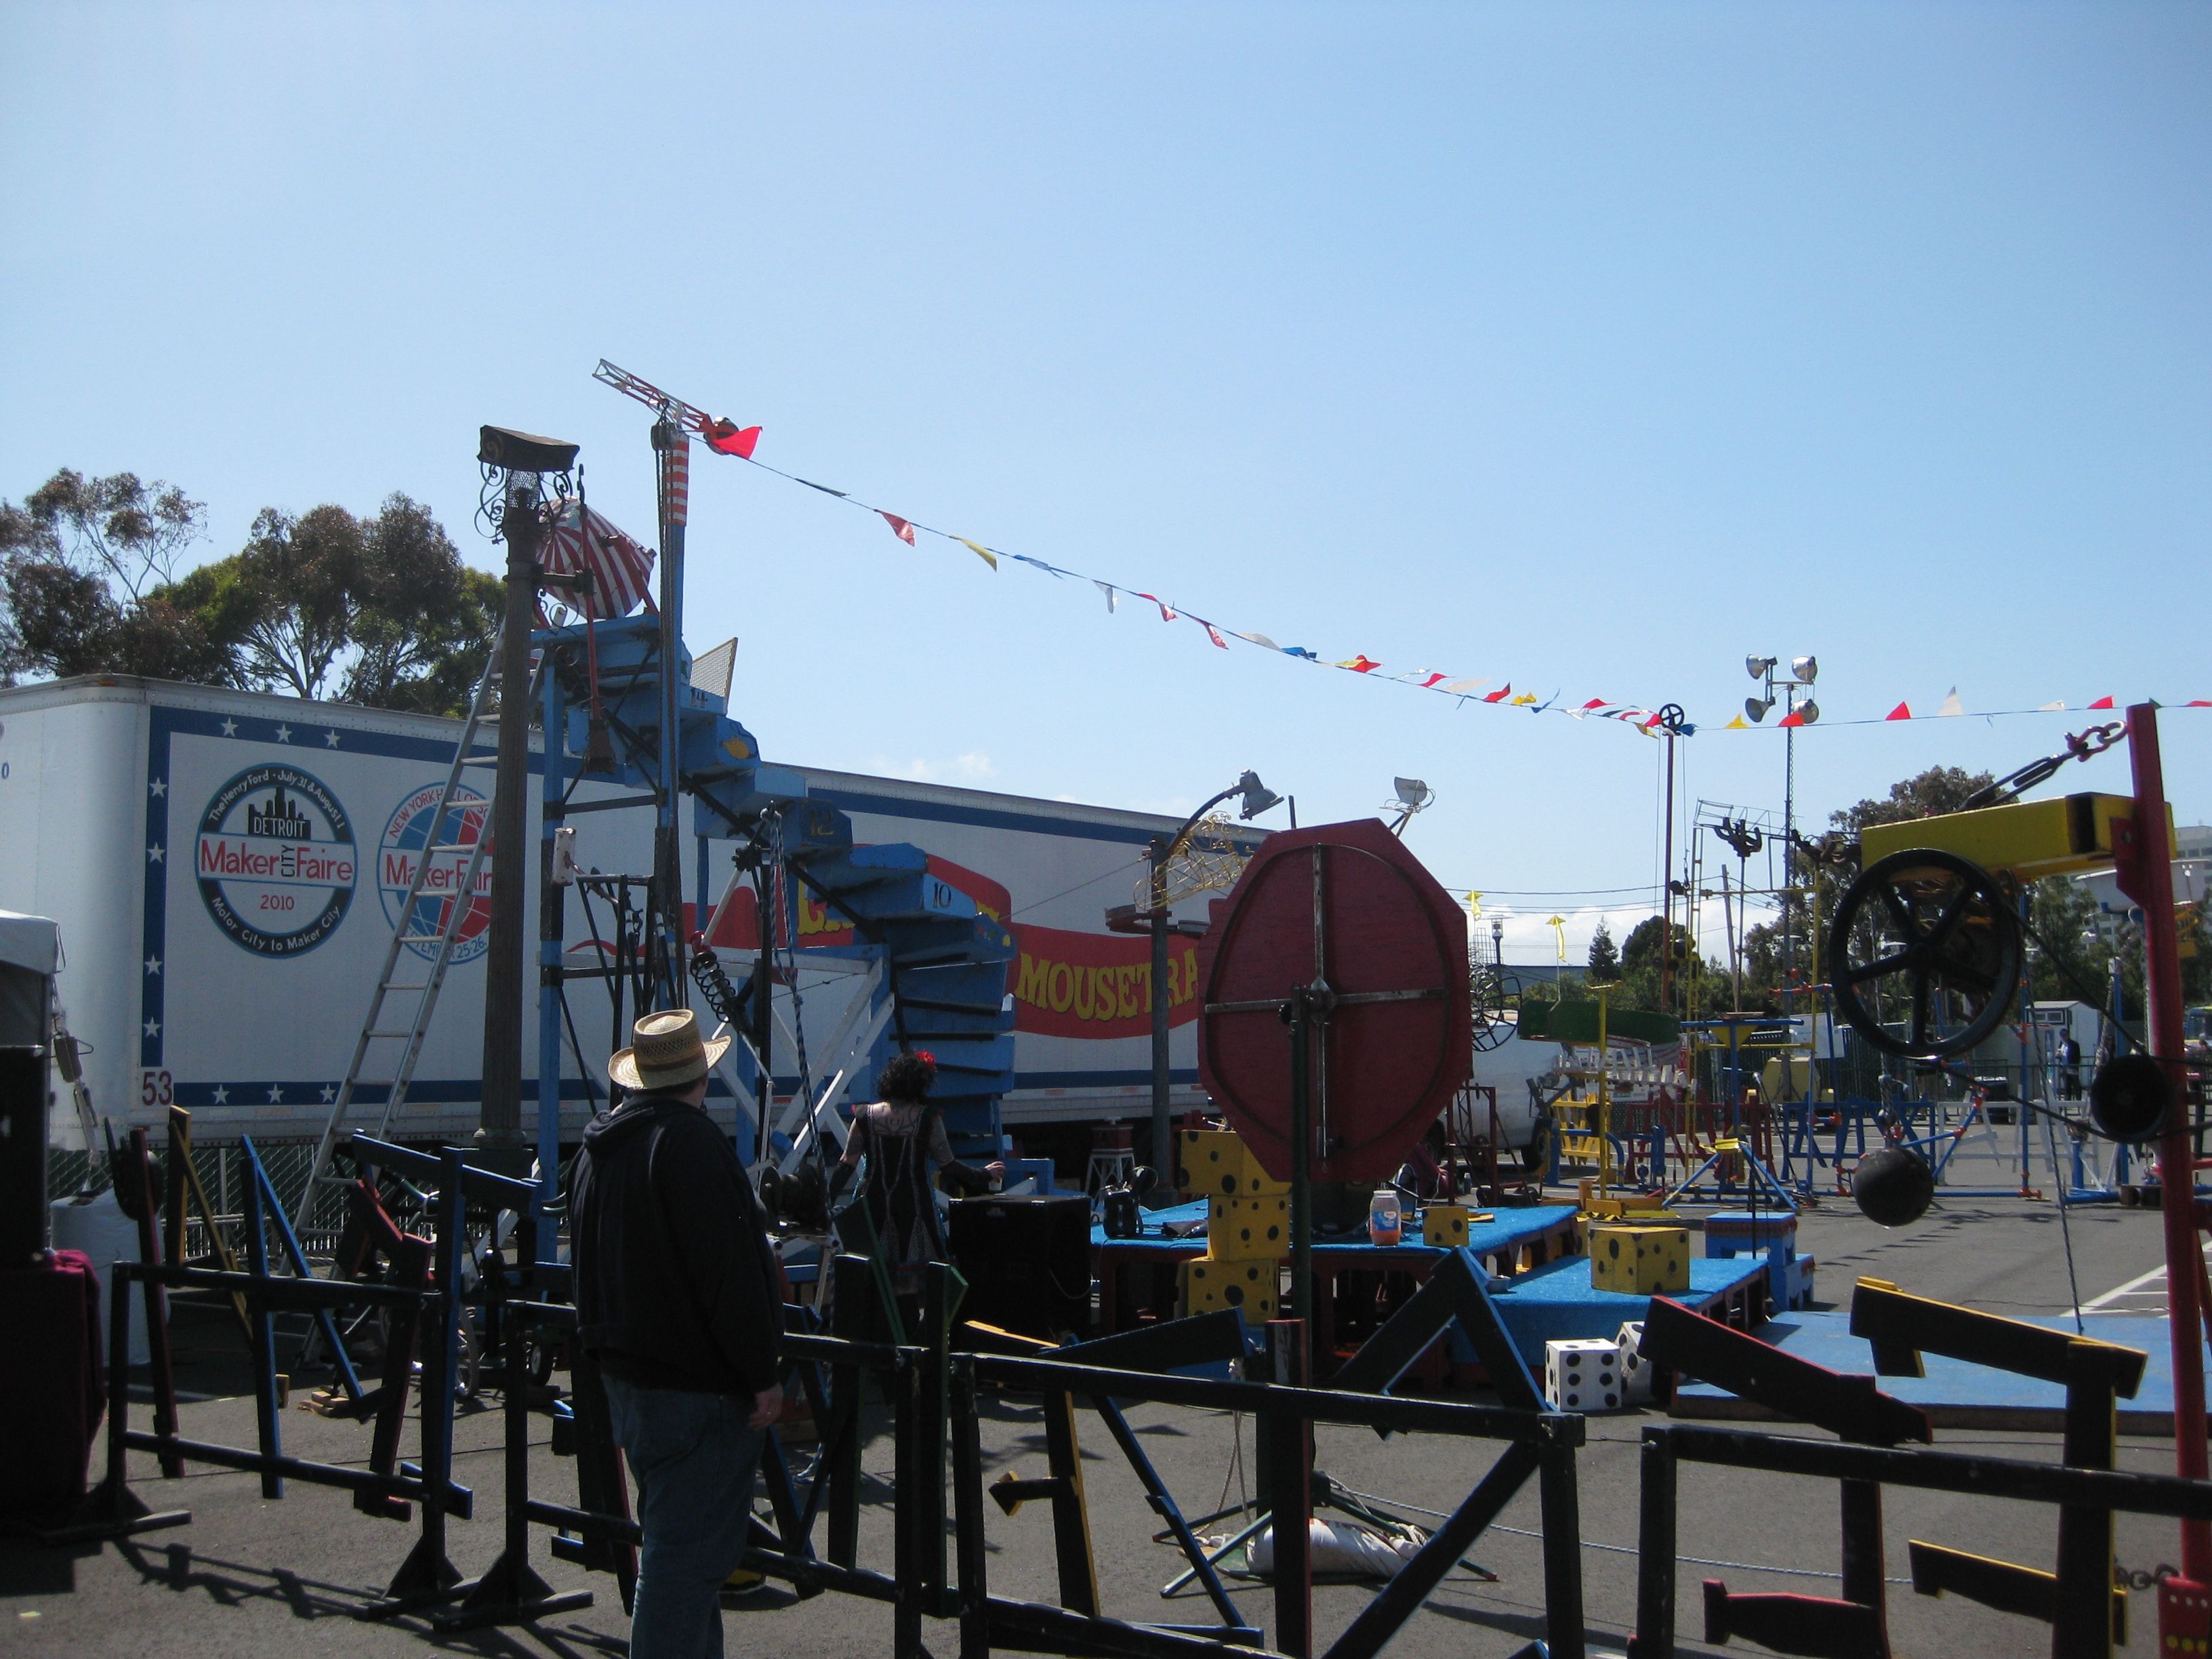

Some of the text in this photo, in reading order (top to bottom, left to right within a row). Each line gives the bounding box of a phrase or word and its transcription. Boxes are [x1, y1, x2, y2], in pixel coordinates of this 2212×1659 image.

[208, 801, 226, 821] The
[224, 781, 247, 804] Henry
[247, 770, 269, 785] Ford
[278, 770, 298, 785] July
[298, 777, 308, 788] 31
[308, 782, 315, 793] &
[314, 788, 342, 823] August
[254, 817, 305, 837] DETROIT
[389, 808, 411, 838] NEW
[408, 791, 434, 813] YORK
[201, 840, 353, 881] Maker Faire
[281, 844, 295, 877] CITY
[457, 859, 493, 890] Fir
[260, 895, 295, 910] 2010
[933, 882, 951, 908] 10
[212, 897, 340, 951] Motor City to Maker City
[142, 1071, 172, 1105] 53
